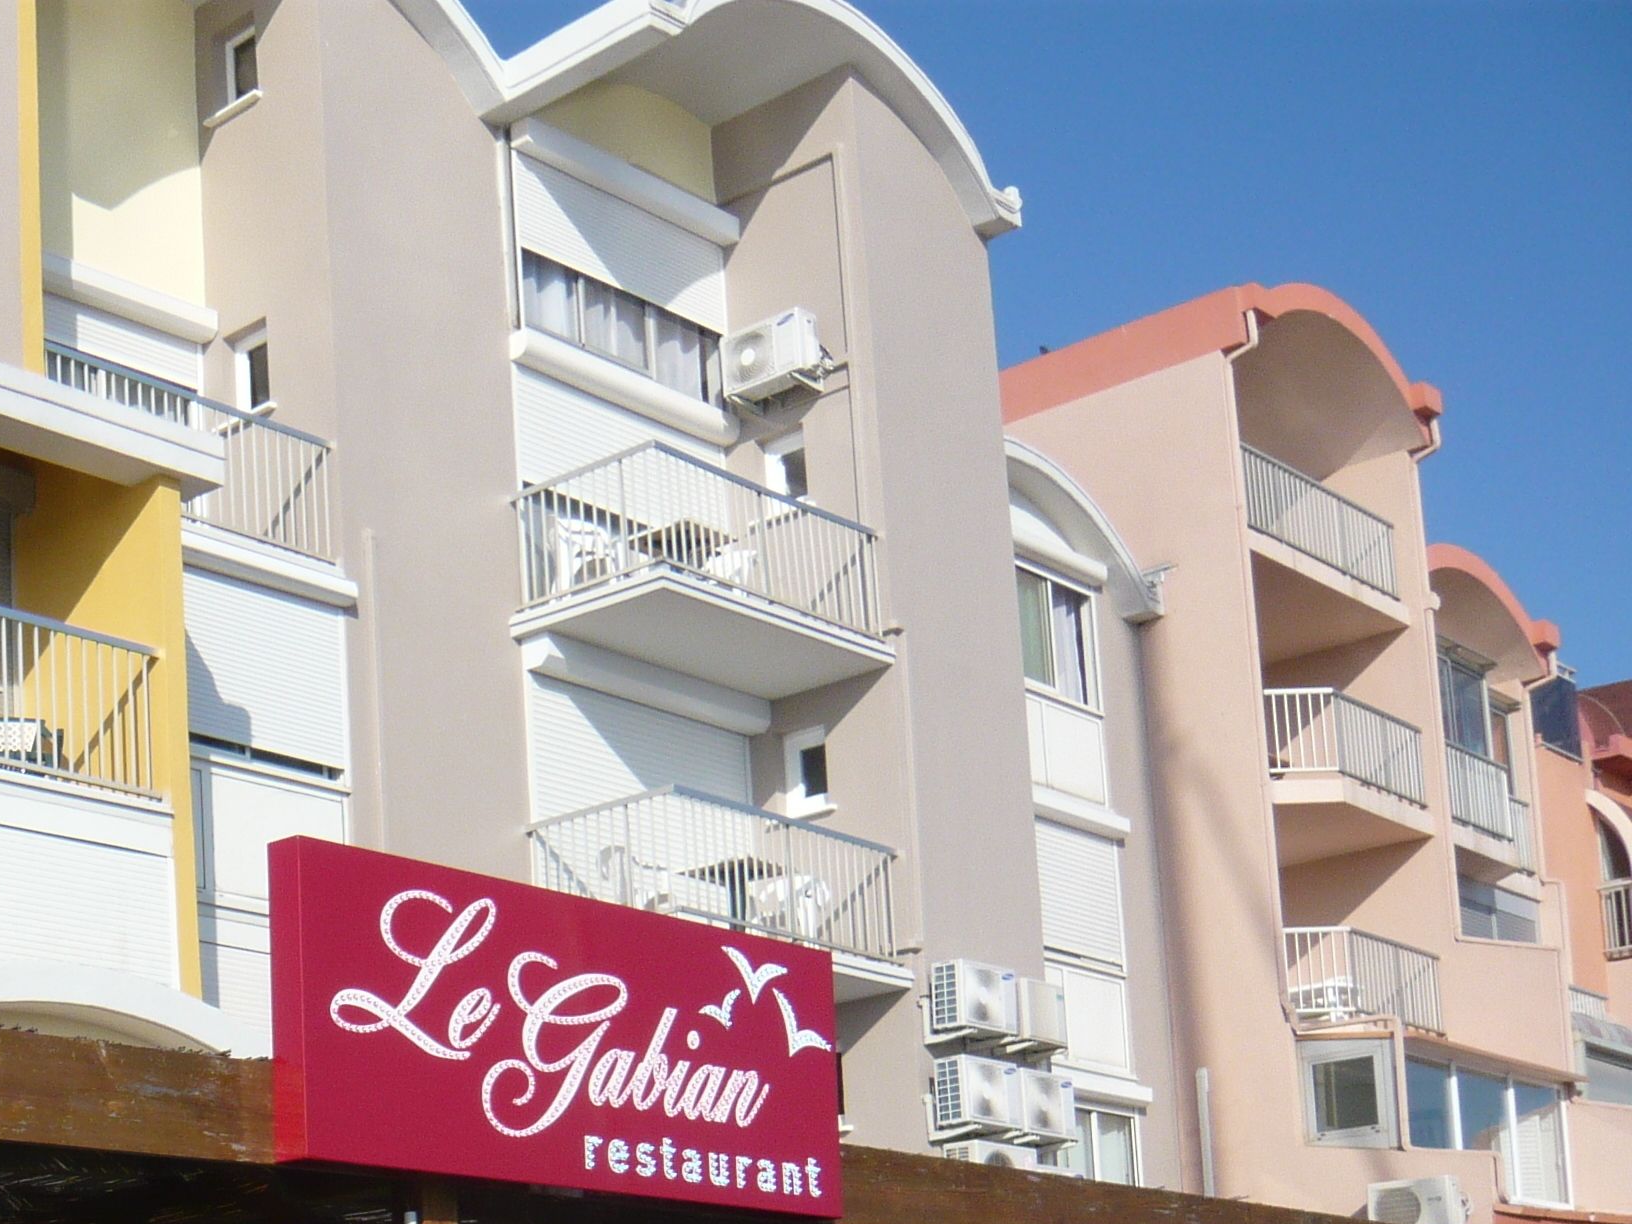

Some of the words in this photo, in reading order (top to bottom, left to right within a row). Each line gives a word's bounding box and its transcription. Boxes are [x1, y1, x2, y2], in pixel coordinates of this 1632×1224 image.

[330, 889, 501, 1061] Le
[481, 950, 770, 1138] Gabian
[584, 1134, 824, 1198] restaurant
